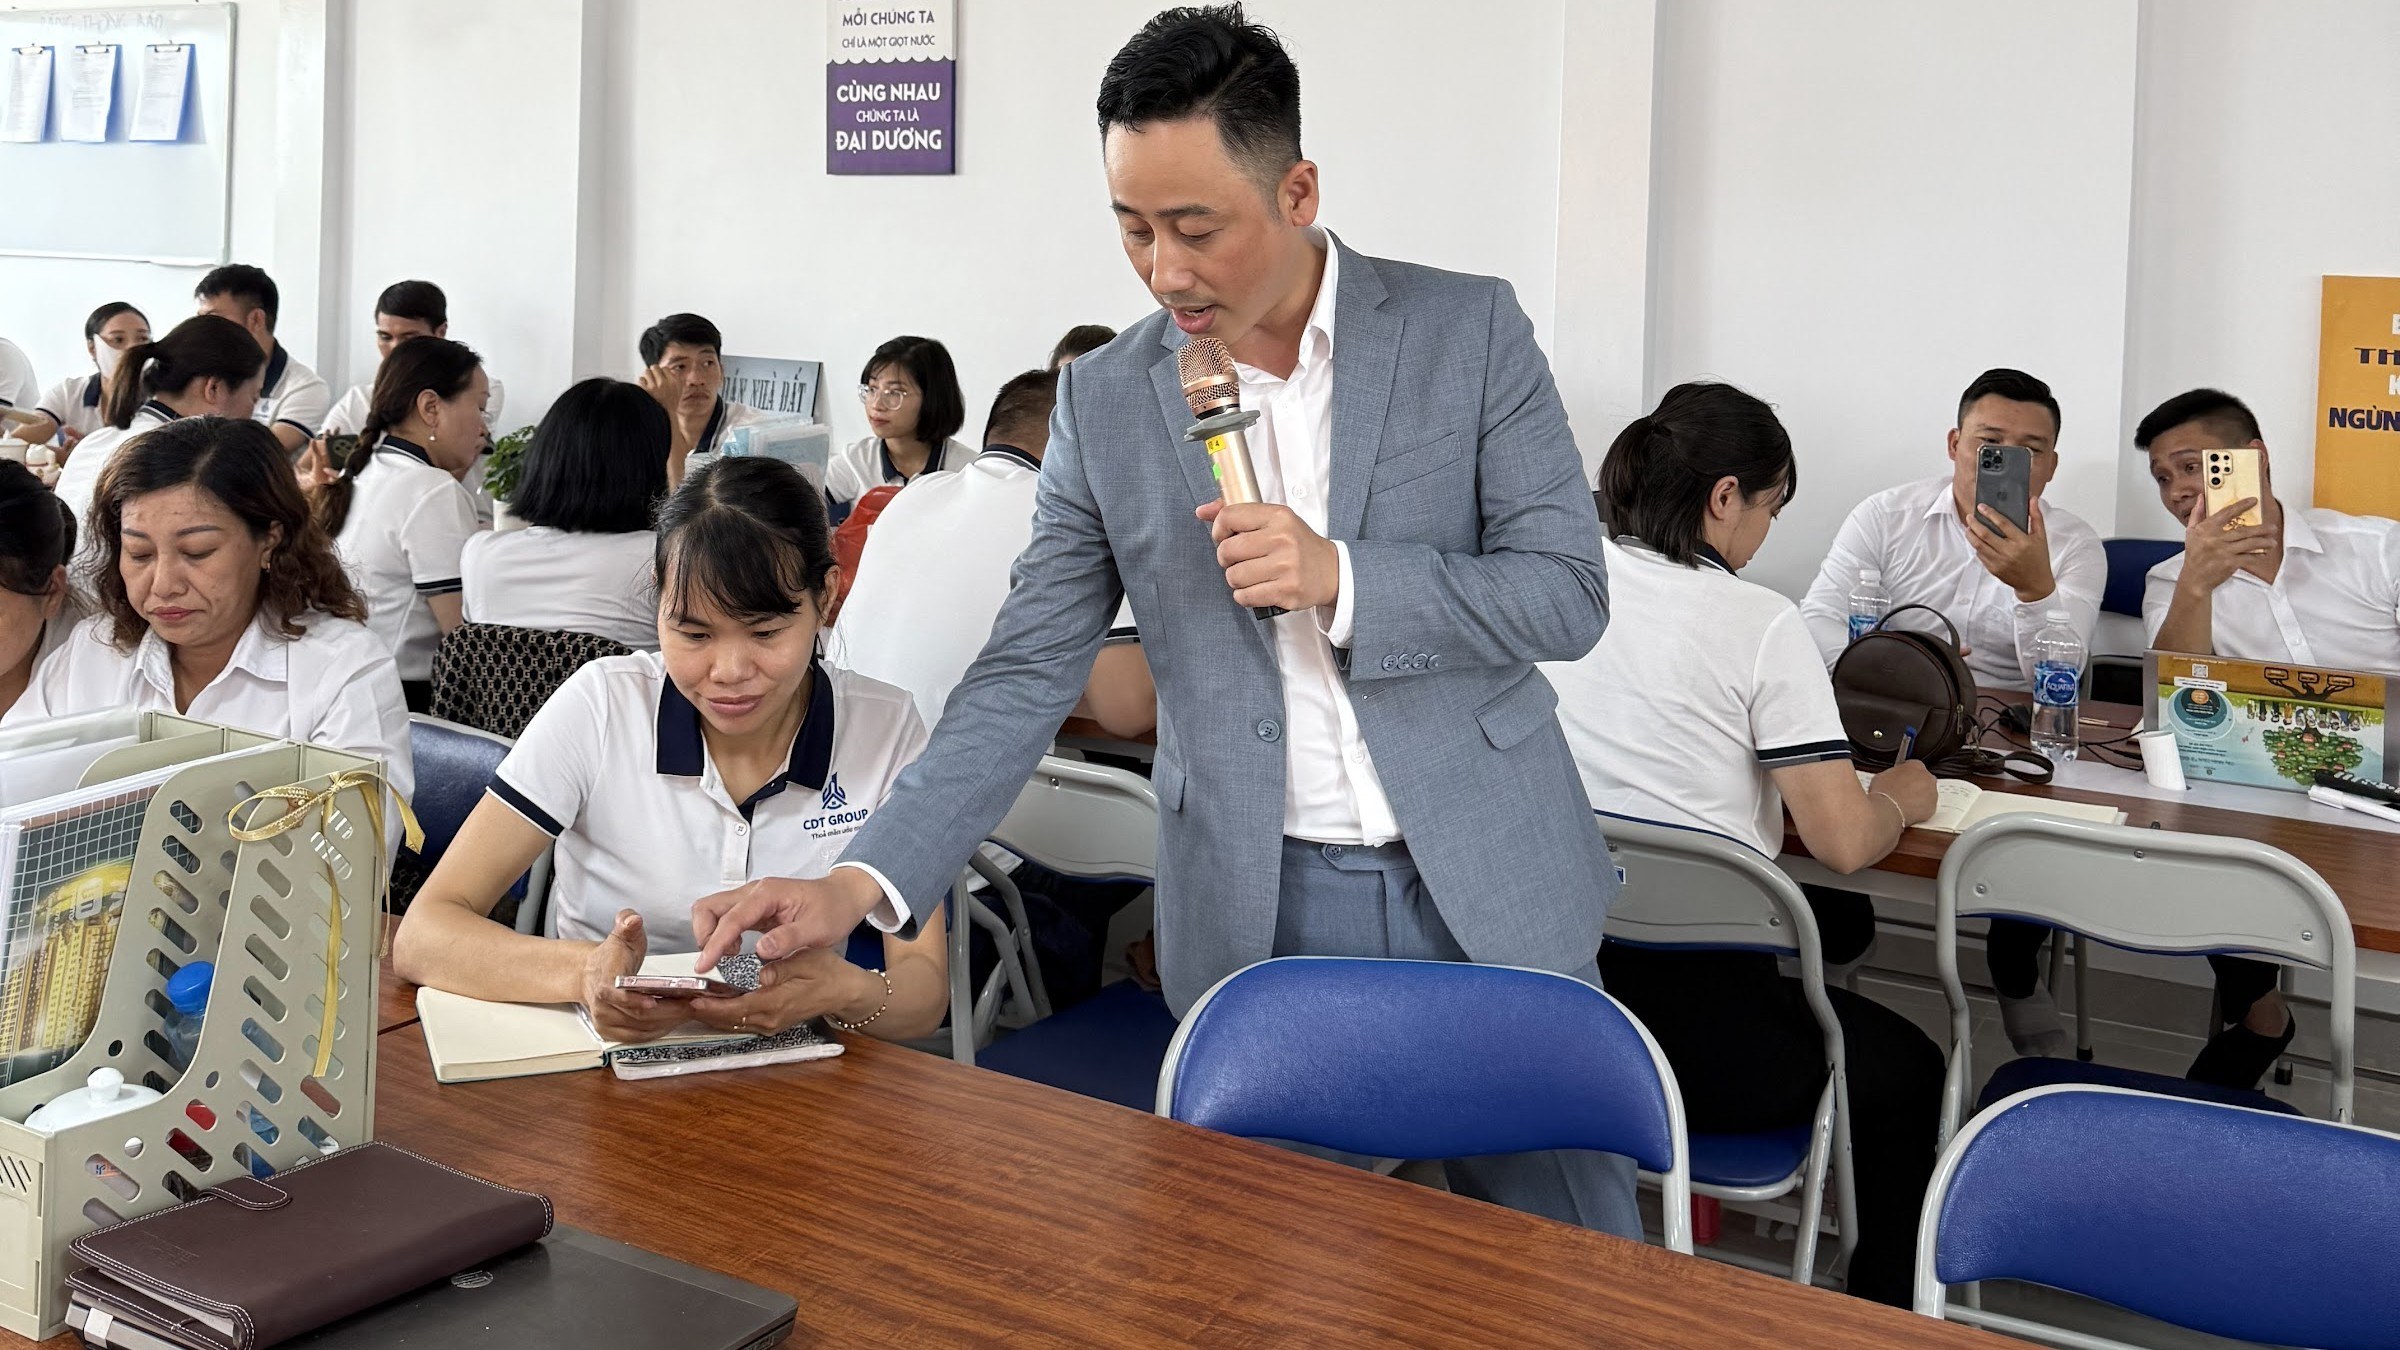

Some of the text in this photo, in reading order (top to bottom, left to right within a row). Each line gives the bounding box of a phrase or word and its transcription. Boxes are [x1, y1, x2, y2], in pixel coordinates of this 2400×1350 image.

[870, 8, 915, 25] CHÚNG
[918, 10, 935, 24] TA
[857, 36, 867, 48] LÀ
[868, 35, 887, 48] MỘT
[910, 34, 936, 46] NƯỚC
[836, 79, 941, 103] CÙNG NHAU
[856, 107, 920, 123] CHÚNG TA LÀ
[835, 127, 942, 154] ĐẠI DƯƠNG
[803, 808, 868, 831] CDT GROUP
